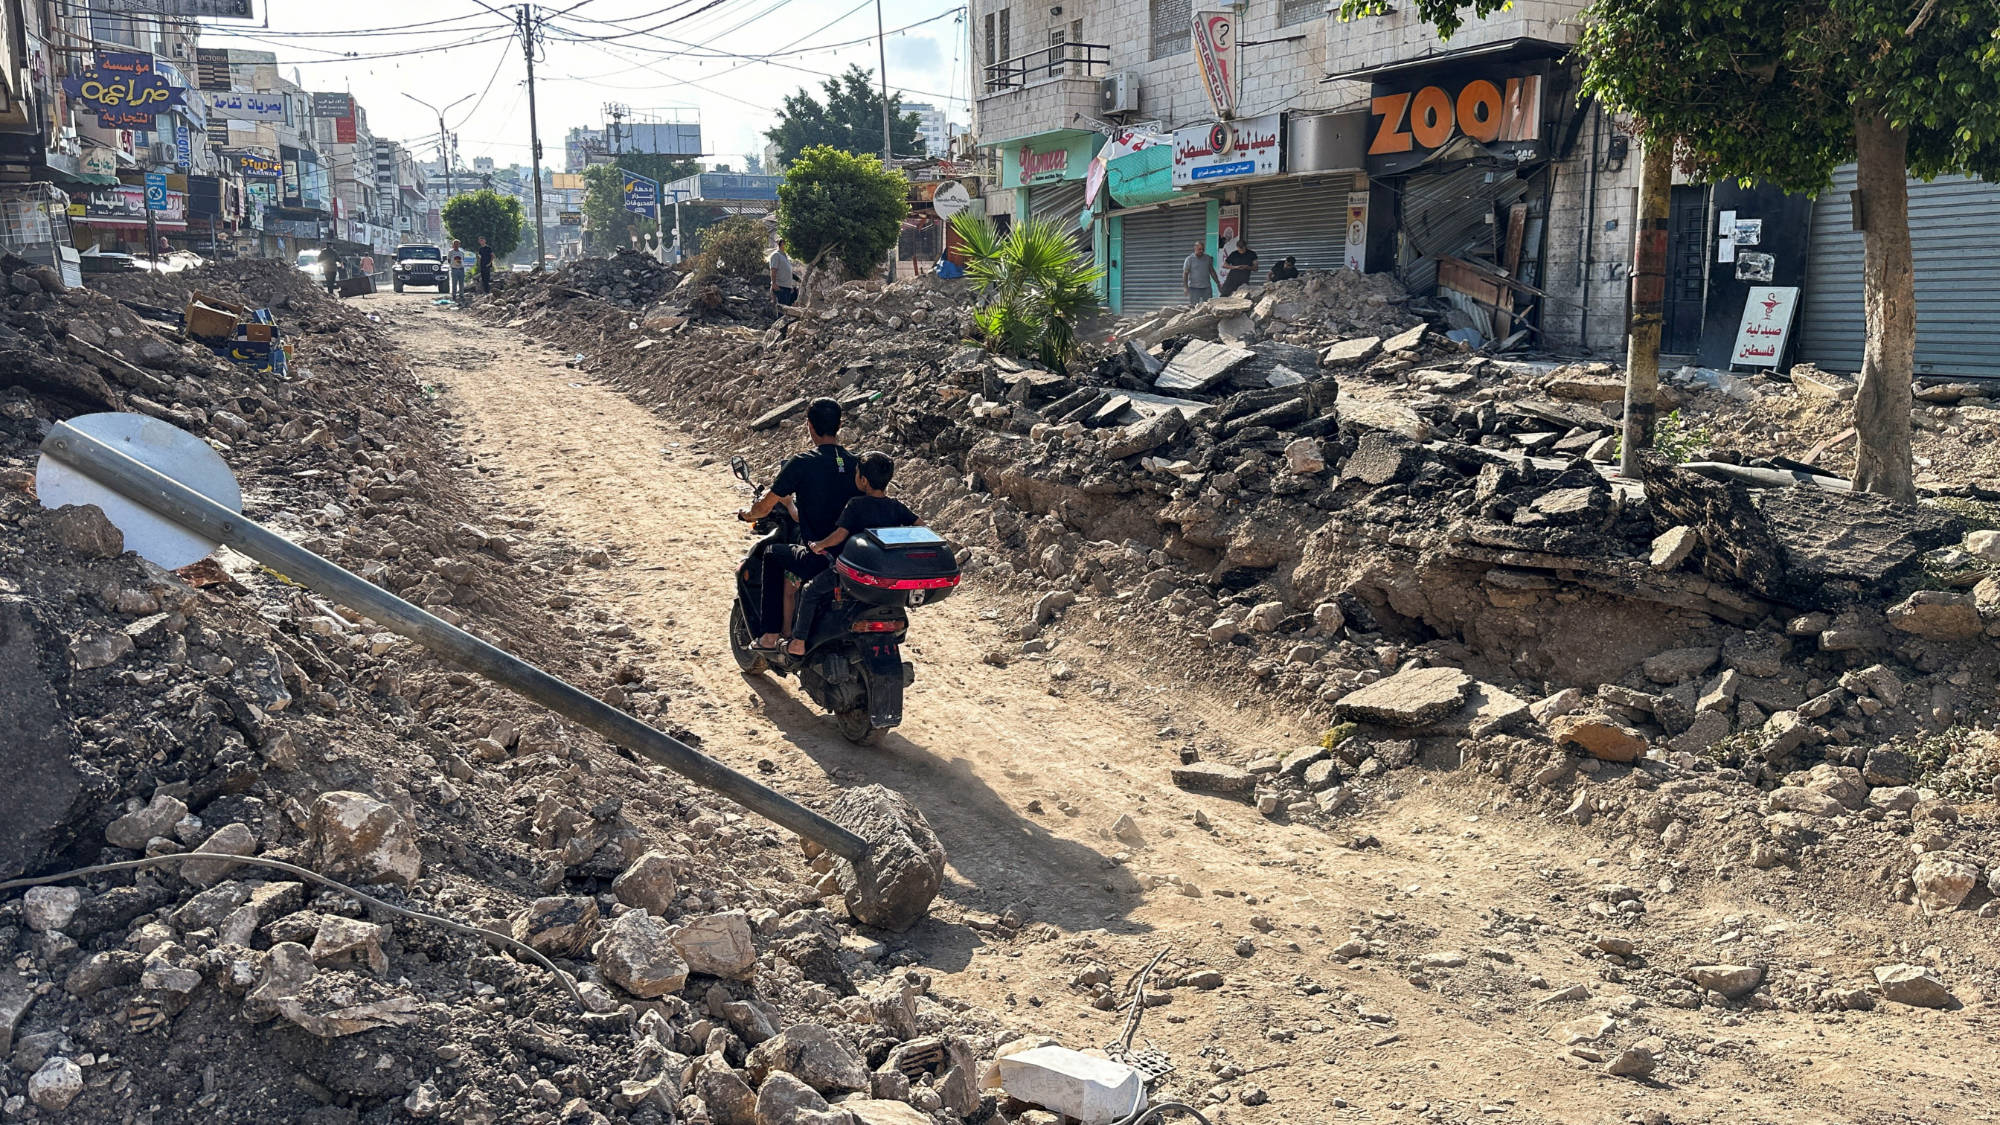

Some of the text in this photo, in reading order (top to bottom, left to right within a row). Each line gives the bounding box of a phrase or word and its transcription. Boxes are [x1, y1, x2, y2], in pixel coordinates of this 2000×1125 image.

[99, 54, 150, 75] مؤسسة
[197, 54, 228, 63] VICTORIA
[81, 72, 169, 106] ضراغمة
[212, 95, 282, 115] بصريات تفاحة
[100, 108, 153, 128] التجارية
[178, 126, 190, 168] STUDIO
[1175, 137, 1214, 166] لسطين
[1233, 127, 1276, 158] صيدلية
[1746, 322, 1782, 338] صيدلية
[1739, 343, 1775, 358] فلسطين
